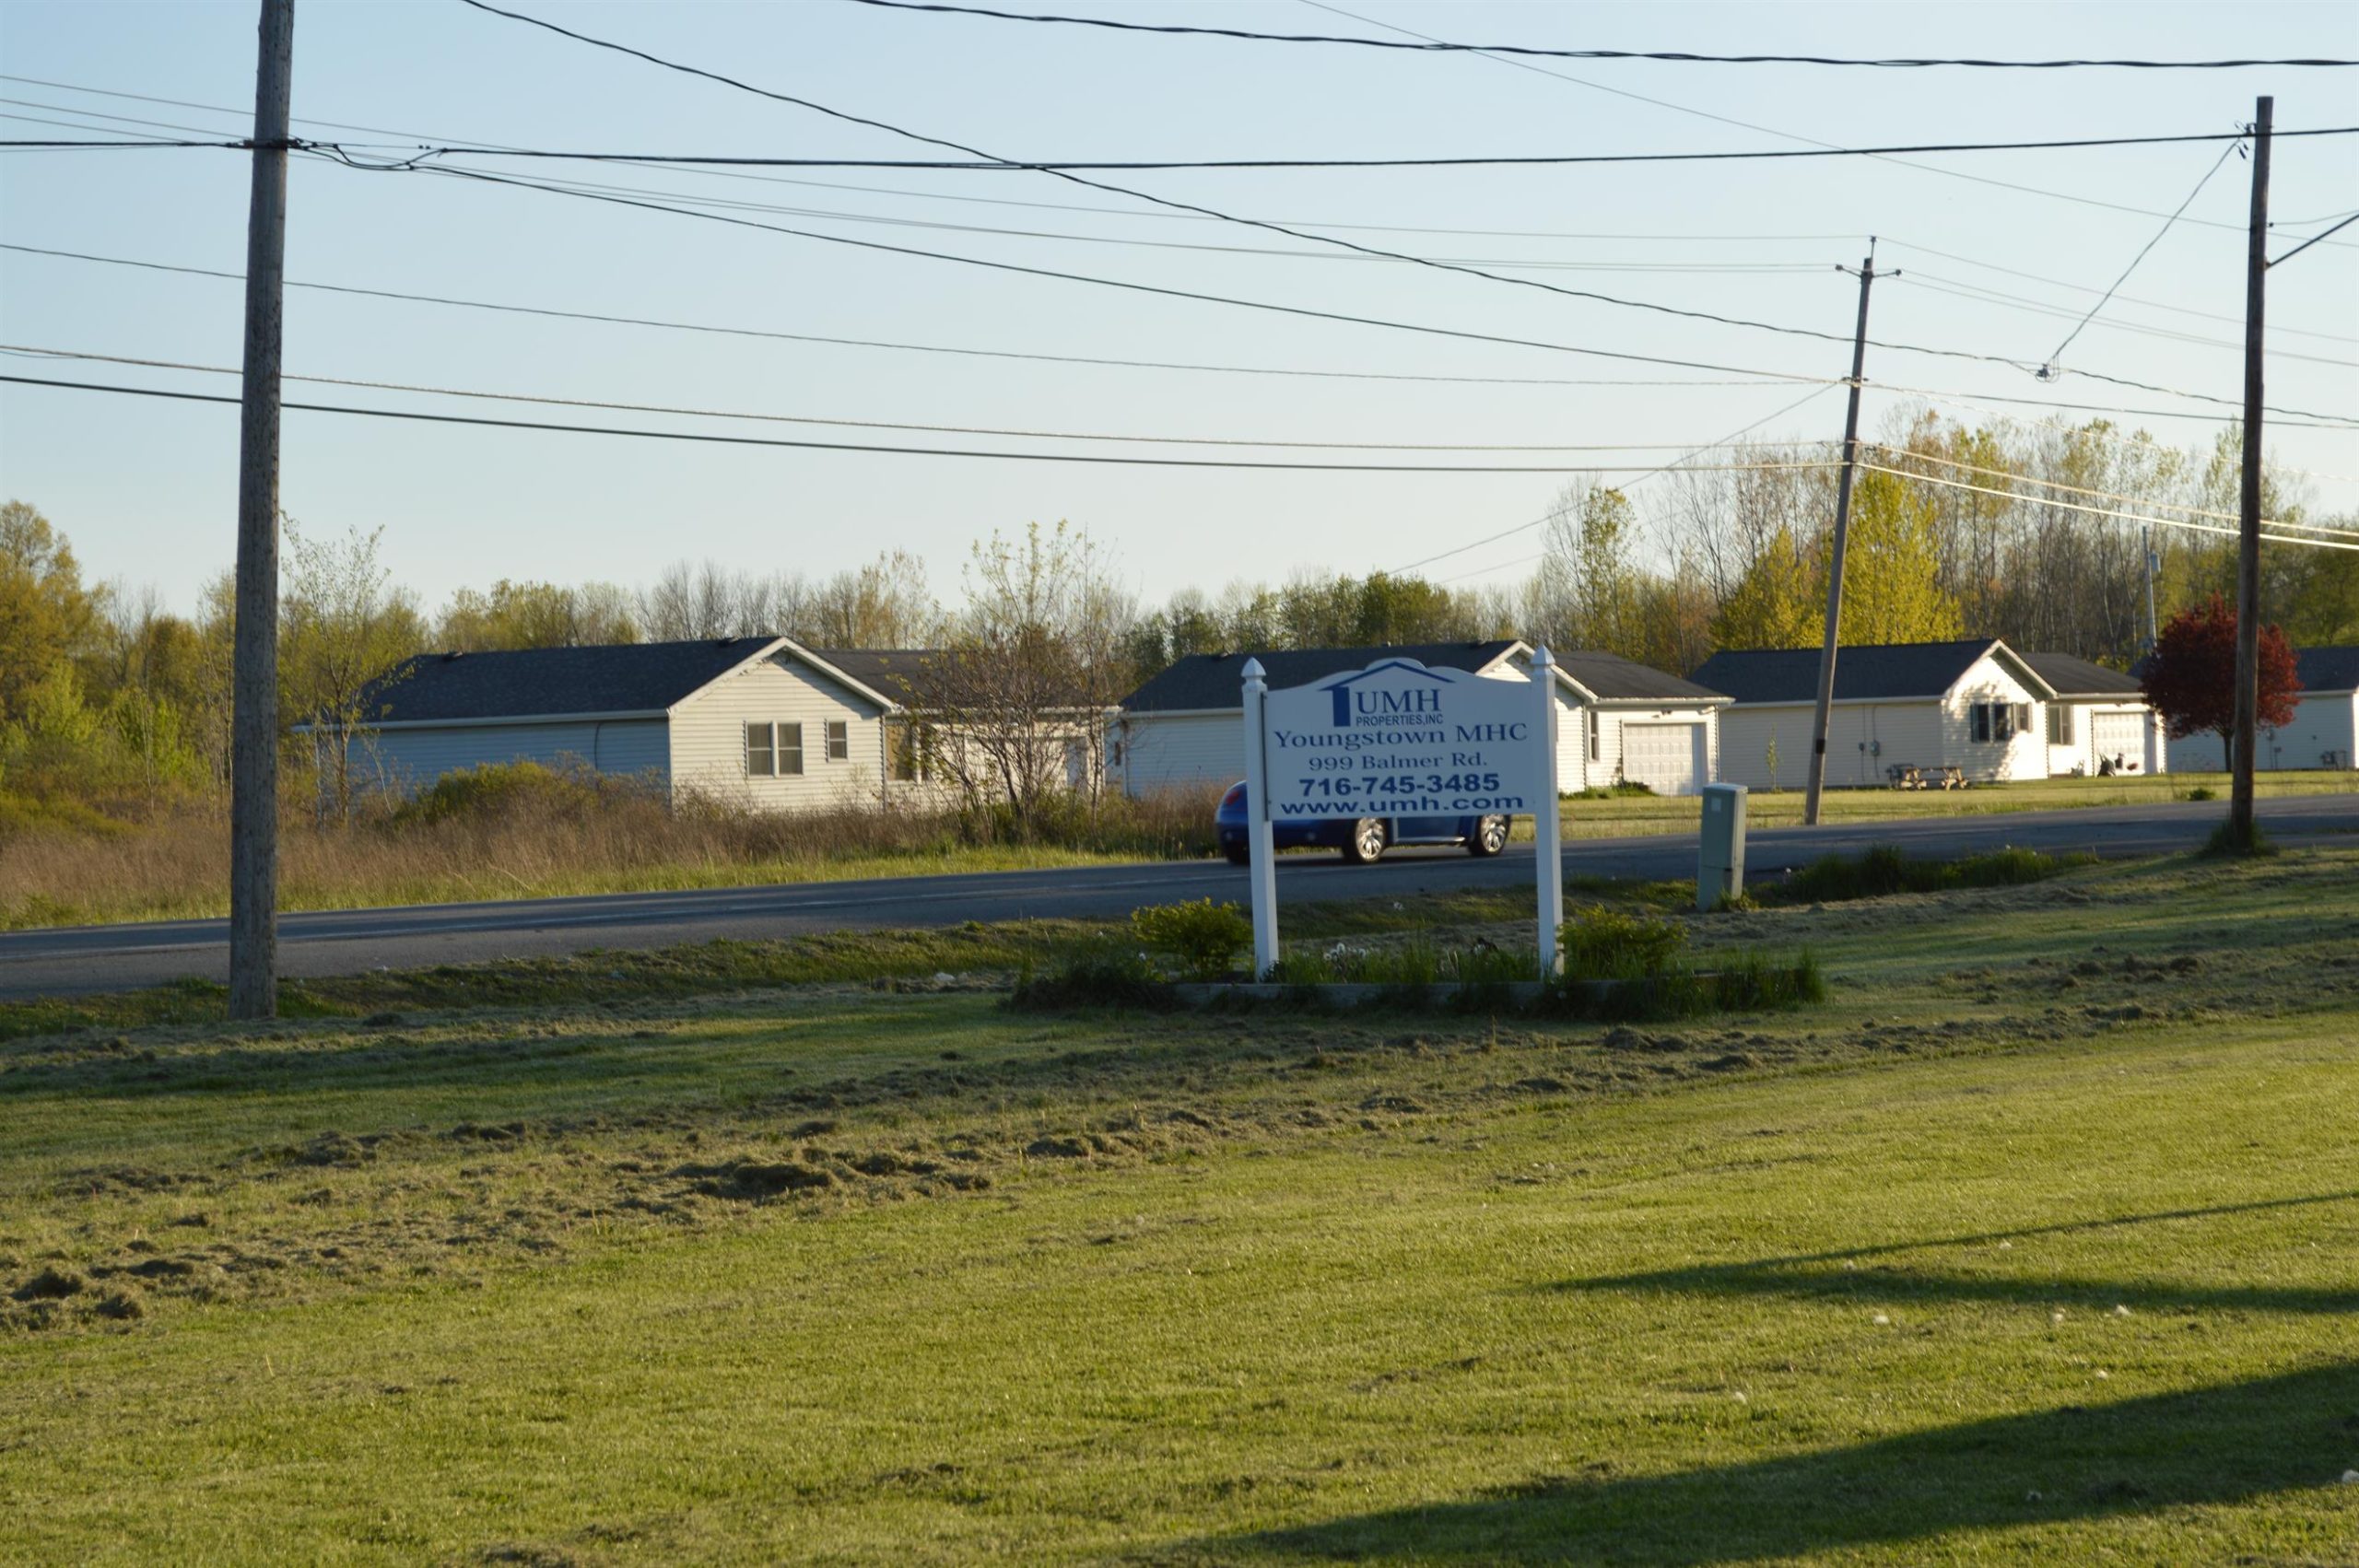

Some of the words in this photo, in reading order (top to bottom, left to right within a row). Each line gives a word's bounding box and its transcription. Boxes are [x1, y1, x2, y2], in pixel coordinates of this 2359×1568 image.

[1356, 688, 1442, 715] UMH
[1274, 730, 1446, 751] Youngstown
[1454, 722, 1528, 743] MHC
[1309, 755, 1353, 771] 999
[1361, 754, 1444, 770] Balmer
[1451, 752, 1487, 767] Rd.
[1299, 773, 1500, 797] 716-745-3485
[1281, 795, 1523, 814] www.umh.com
